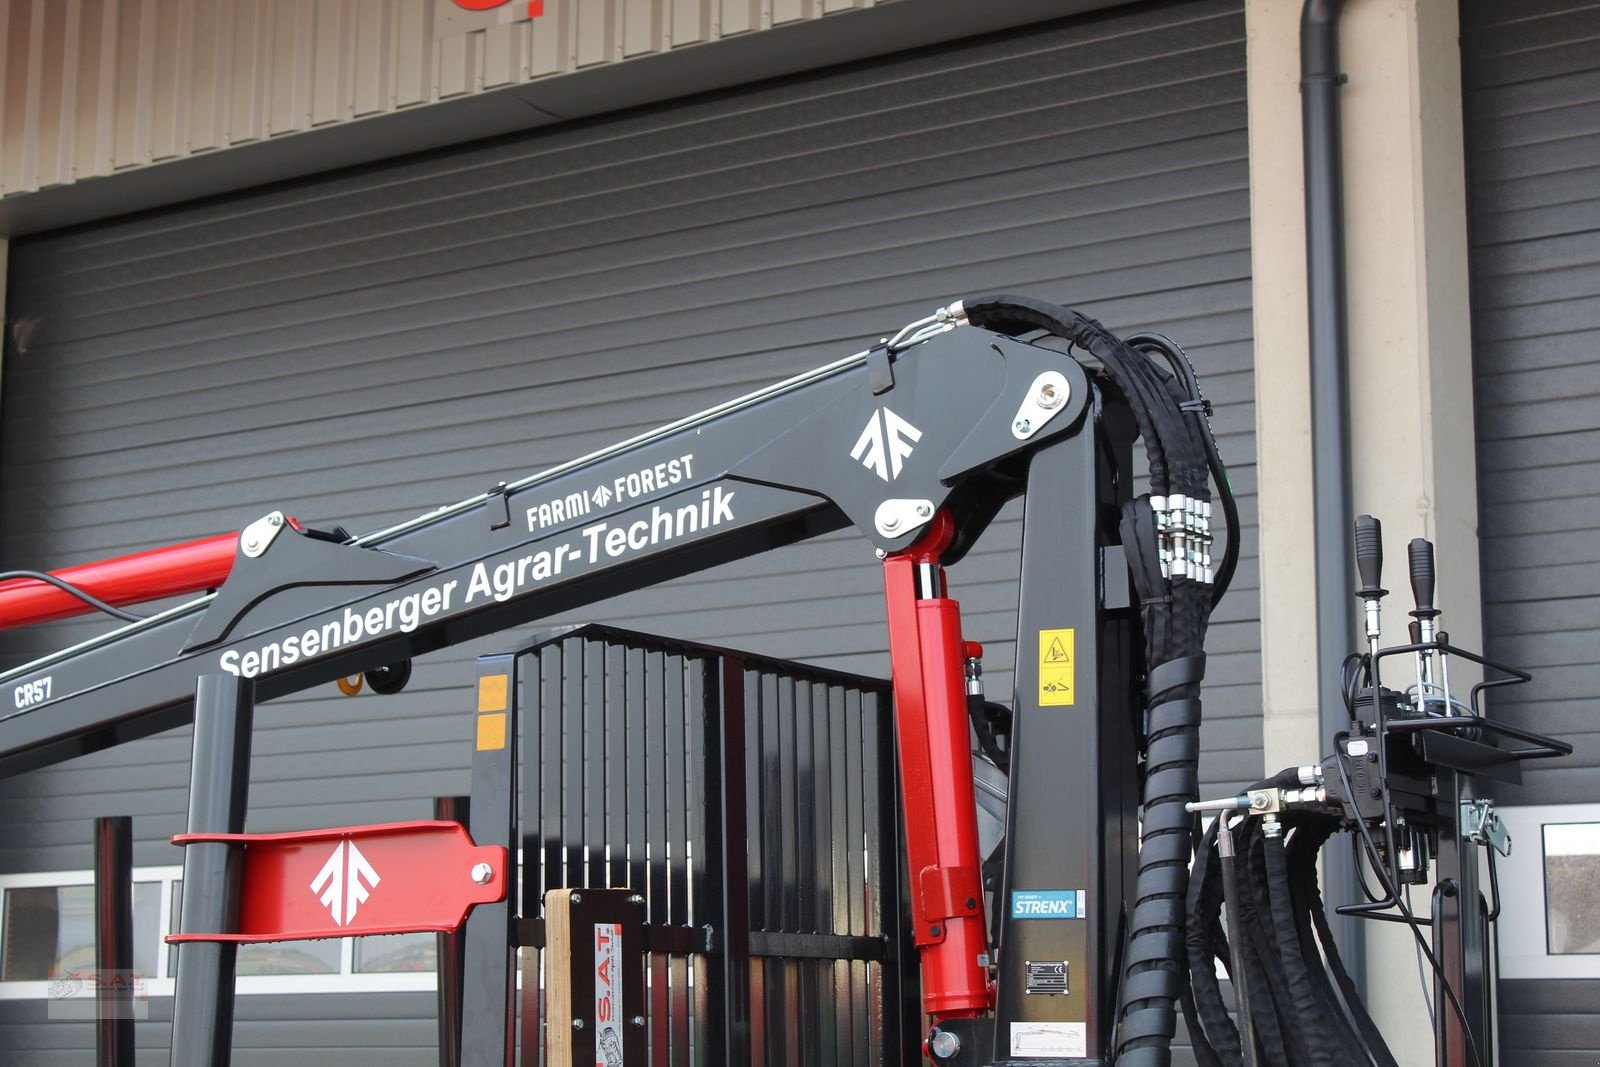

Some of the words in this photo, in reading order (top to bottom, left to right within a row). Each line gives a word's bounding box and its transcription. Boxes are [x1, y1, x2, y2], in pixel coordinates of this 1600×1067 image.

[526, 490, 591, 532] FARMI
[614, 454, 694, 502] FOREST
[219, 580, 457, 679] Sensenberger
[464, 486, 735, 603] Agrar-Technik
[14, 676, 52, 709] CR57
[597, 928, 611, 1022] S.A.T.
